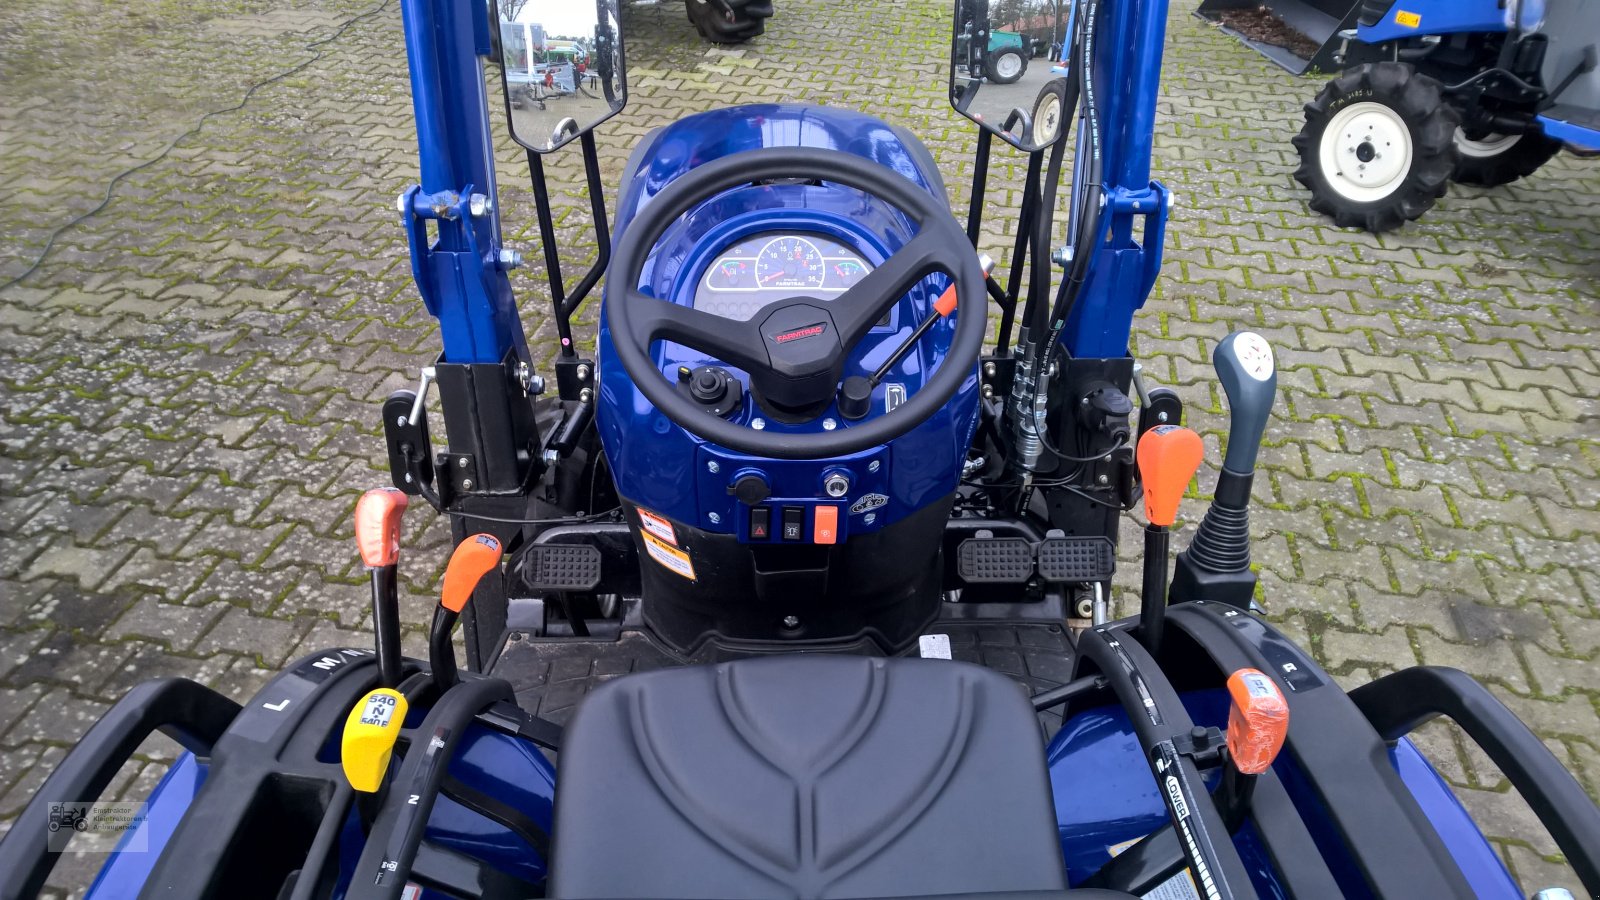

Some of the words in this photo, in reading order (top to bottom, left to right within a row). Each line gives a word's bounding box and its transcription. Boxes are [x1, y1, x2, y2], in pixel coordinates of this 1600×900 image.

[776, 326, 822, 341] FARMTRAC
[312, 656, 341, 670] M
[262, 699, 291, 712] L
[369, 695, 396, 706] 540
[372, 707, 386, 716] N
[408, 795, 420, 805] N
[1167, 779, 1187, 818] LOWER
